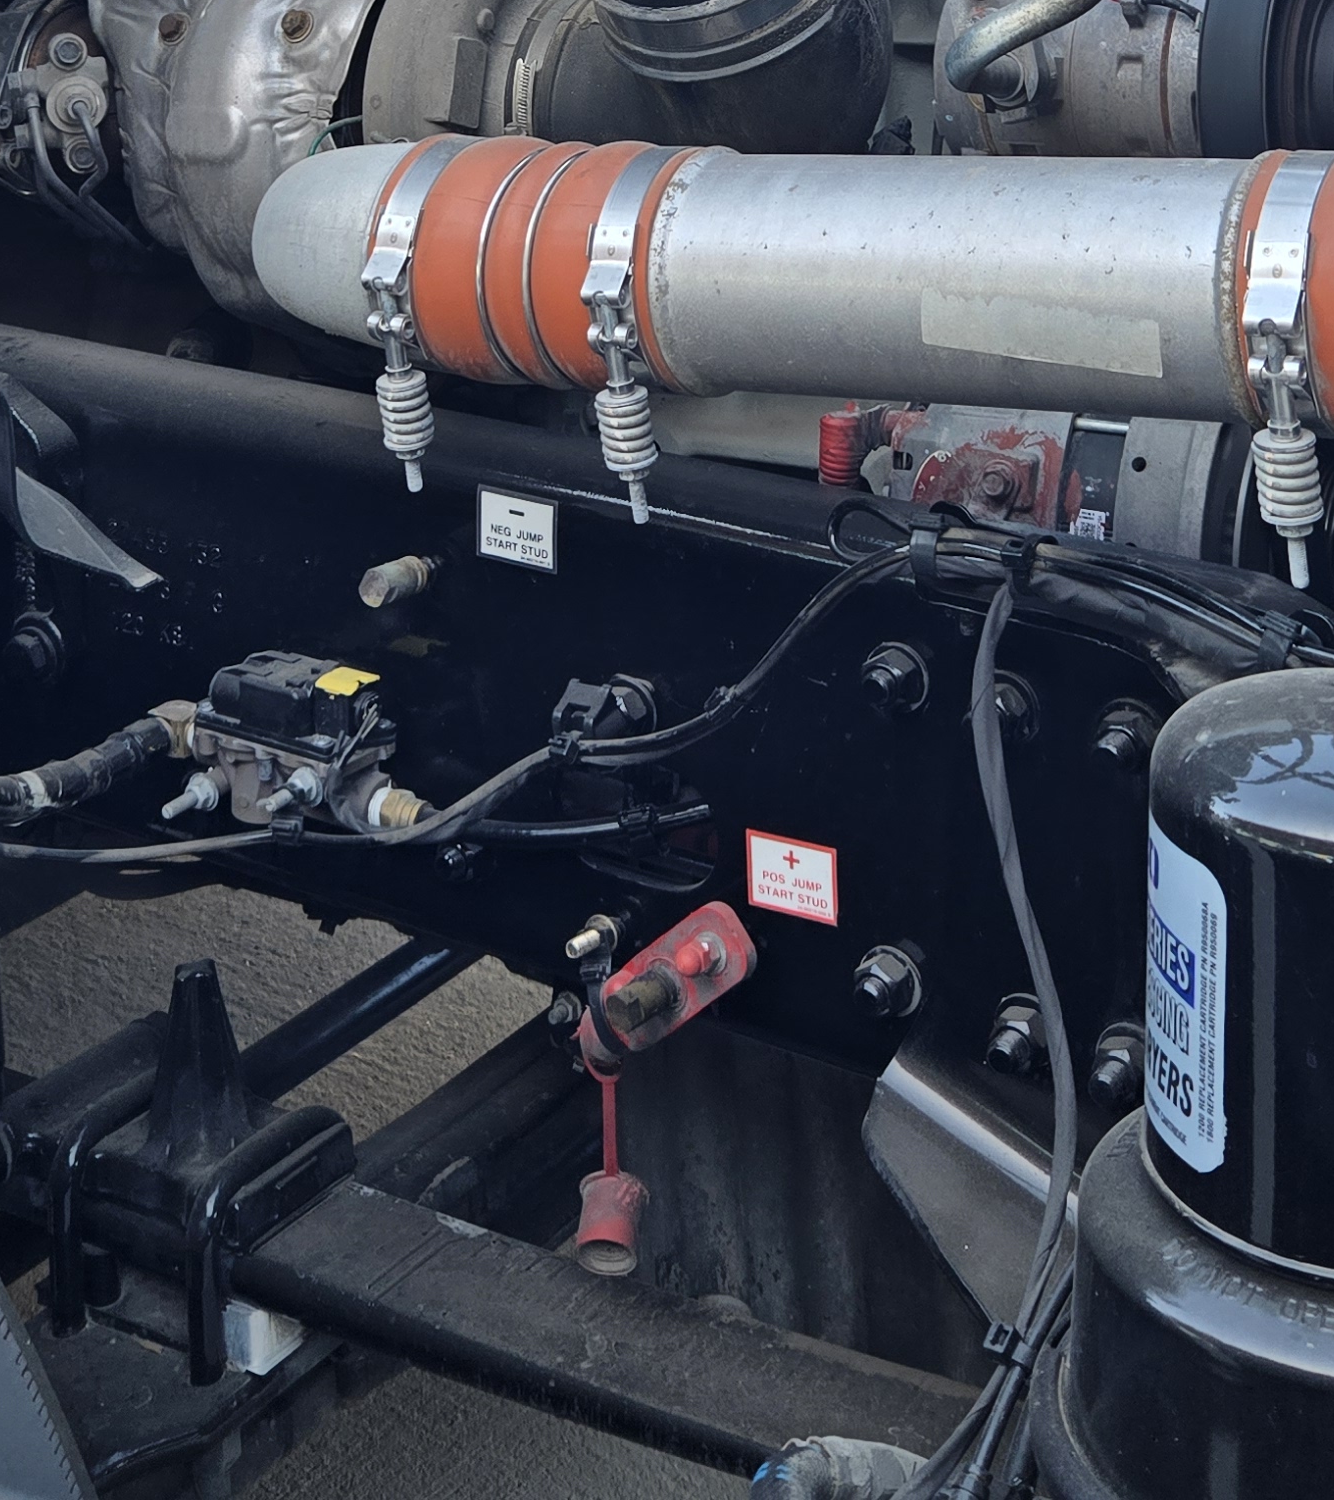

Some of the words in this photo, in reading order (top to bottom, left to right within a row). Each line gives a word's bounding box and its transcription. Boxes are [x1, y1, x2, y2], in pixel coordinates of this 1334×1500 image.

[486, 536, 518, 552] START
[521, 543, 549, 559] STUD
[491, 523, 512, 537] NEG
[516, 529, 544, 543] JUMP
[758, 884, 794, 901] START
[798, 893, 828, 909] STUD
[762, 870, 785, 885] POS
[792, 878, 822, 892] JUMP
[1148, 907, 1190, 991] ERIES
[1200, 956, 1208, 971] PN
[1209, 962, 1217, 977] PN
[1199, 972, 1208, 1033] CARTRIDGE
[1208, 977, 1217, 1038] CARTRIDGE
[1147, 1026, 1194, 1118] RYERS
[1198, 1036, 1207, 1115] REPLACEMENT
[1206, 1043, 1216, 1119] REPLACEMENT
